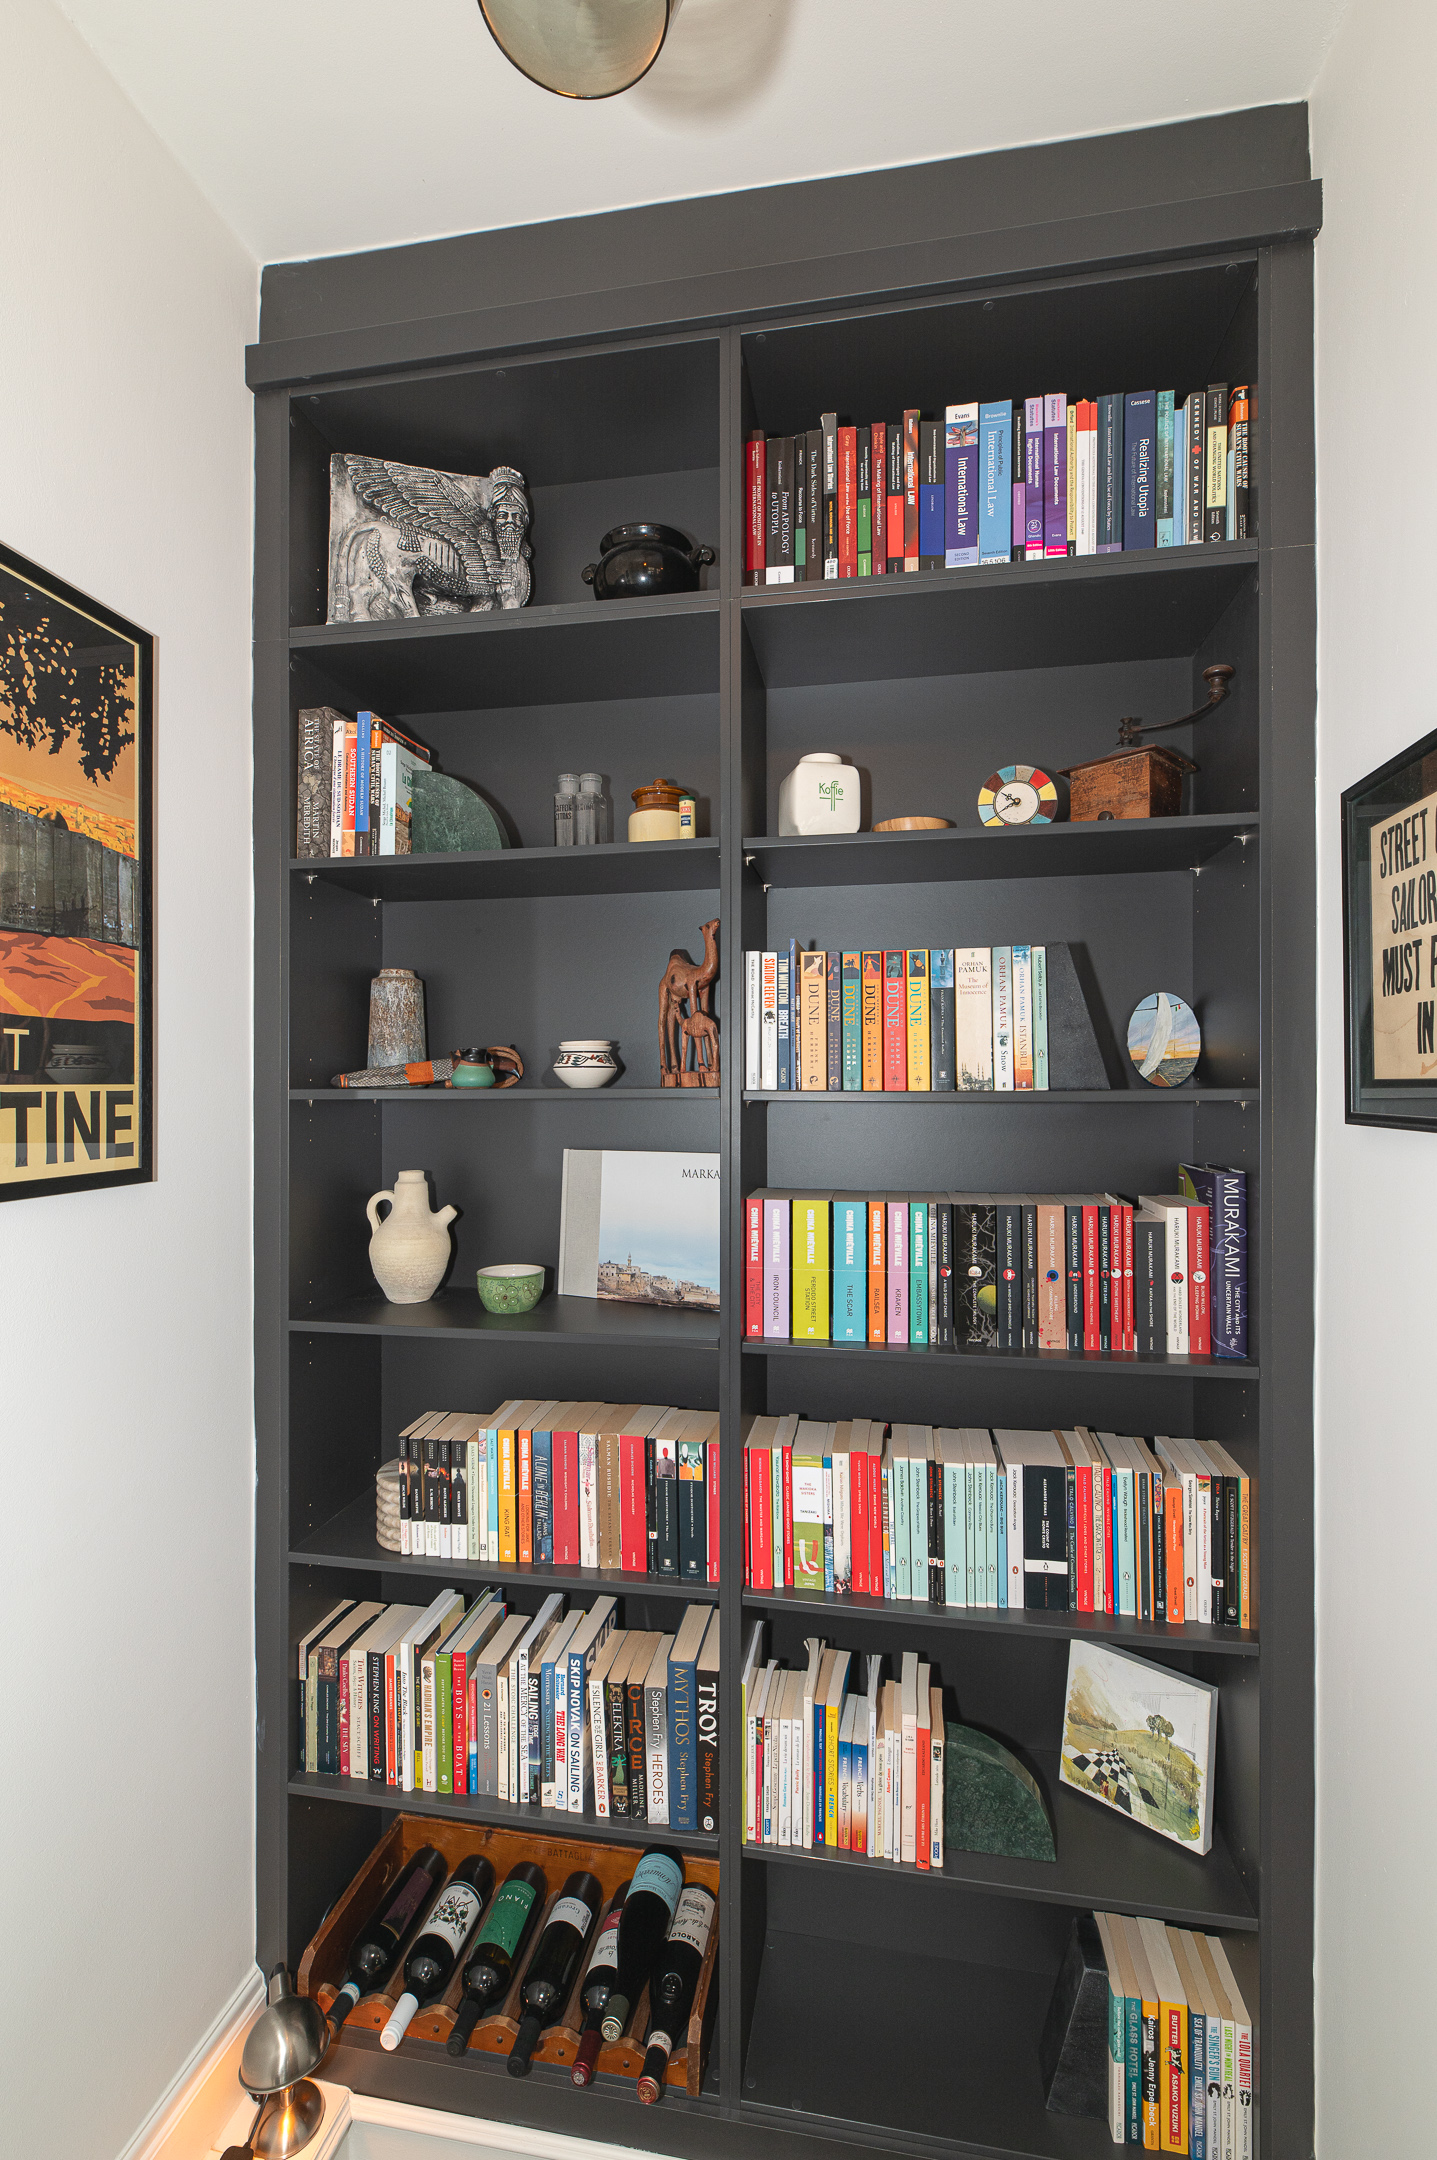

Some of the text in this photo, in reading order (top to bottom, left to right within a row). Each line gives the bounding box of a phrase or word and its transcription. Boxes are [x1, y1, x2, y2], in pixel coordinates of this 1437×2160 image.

[987, 431, 997, 517] International Law
[1138, 438, 1150, 517] Realizing Utopia
[1194, 459, 1199, 470] OF
[957, 457, 968, 535] International Law
[304, 718, 314, 770] AFRICA
[314, 760, 319, 769] OF
[819, 780, 844, 811] Koffie
[1380, 808, 1428, 879] STREET
[764, 959, 775, 1008] STATION ELEVEN
[1382, 939, 1423, 997] MUST
[778, 959, 789, 1039] TIM WINTON BREATH
[809, 984, 819, 1025] DUNE
[831, 990, 839, 1022] DUNE
[844, 985, 855, 1026] DUNE
[865, 985, 875, 1025] DUNE
[887, 981, 899, 1028] DUNE
[910, 981, 922, 1026] DUNE
[1417, 1000, 1435, 1054] IN
[873, 1233, 881, 1265] MIÉVILLE
[1224, 1179, 1240, 1277] MURAKAMI
[535, 1455, 547, 1483] ALONE
[535, 1490, 548, 1519] BERLIN
[373, 1716, 379, 1728] ON
[484, 1702, 492, 1749] 21 Lessons
[556, 1711, 564, 1726] THE
[570, 1659, 580, 1792] SKIP NOVAK ON SAILING
[592, 1690, 601, 1724] SILENCE
[612, 1703, 624, 1750] ELEKTRA
[628, 1685, 642, 1769] CIRCE
[699, 1682, 717, 1747] TROY
[650, 1691, 663, 1805] Stephen Fry HEROES
[675, 1668, 689, 1811] MYTHOS Stephen Fry
[596, 1766, 605, 1800] BARKER
[498, 1894, 529, 1909] FIANO
[671, 1932, 700, 1946] BAROLO
[1130, 2013, 1138, 2078] GLASS HOTEL
[1194, 2038, 1202, 2071] TRANQUILITY
[1239, 2041, 1250, 2057] LOLA
[1148, 2015, 1156, 2126] Kairos Jenny Erpenbeck
[1240, 2059, 1250, 2088] QUARTET
